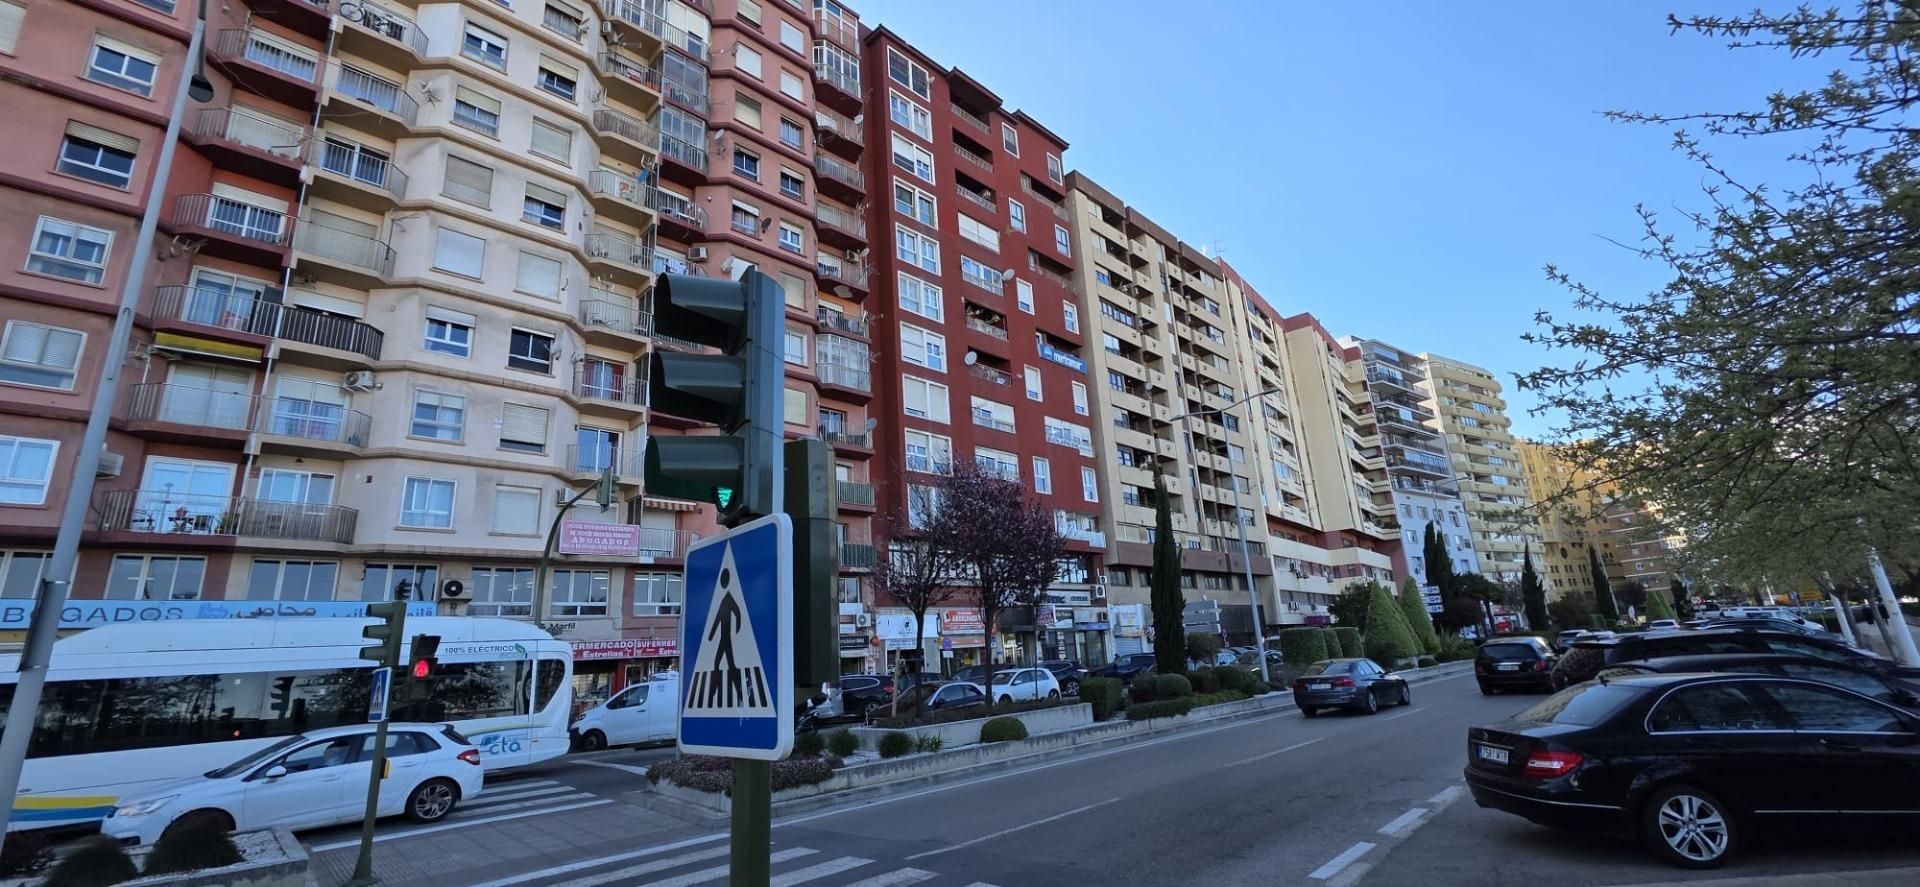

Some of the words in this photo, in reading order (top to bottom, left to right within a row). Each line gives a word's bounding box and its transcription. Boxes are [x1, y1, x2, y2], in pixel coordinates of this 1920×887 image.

[571, 536, 630, 546] ABOGADOS
[2, 606, 184, 623] BGADOS
[573, 641, 634, 650] ERMERCADO
[489, 736, 522, 755] cta
